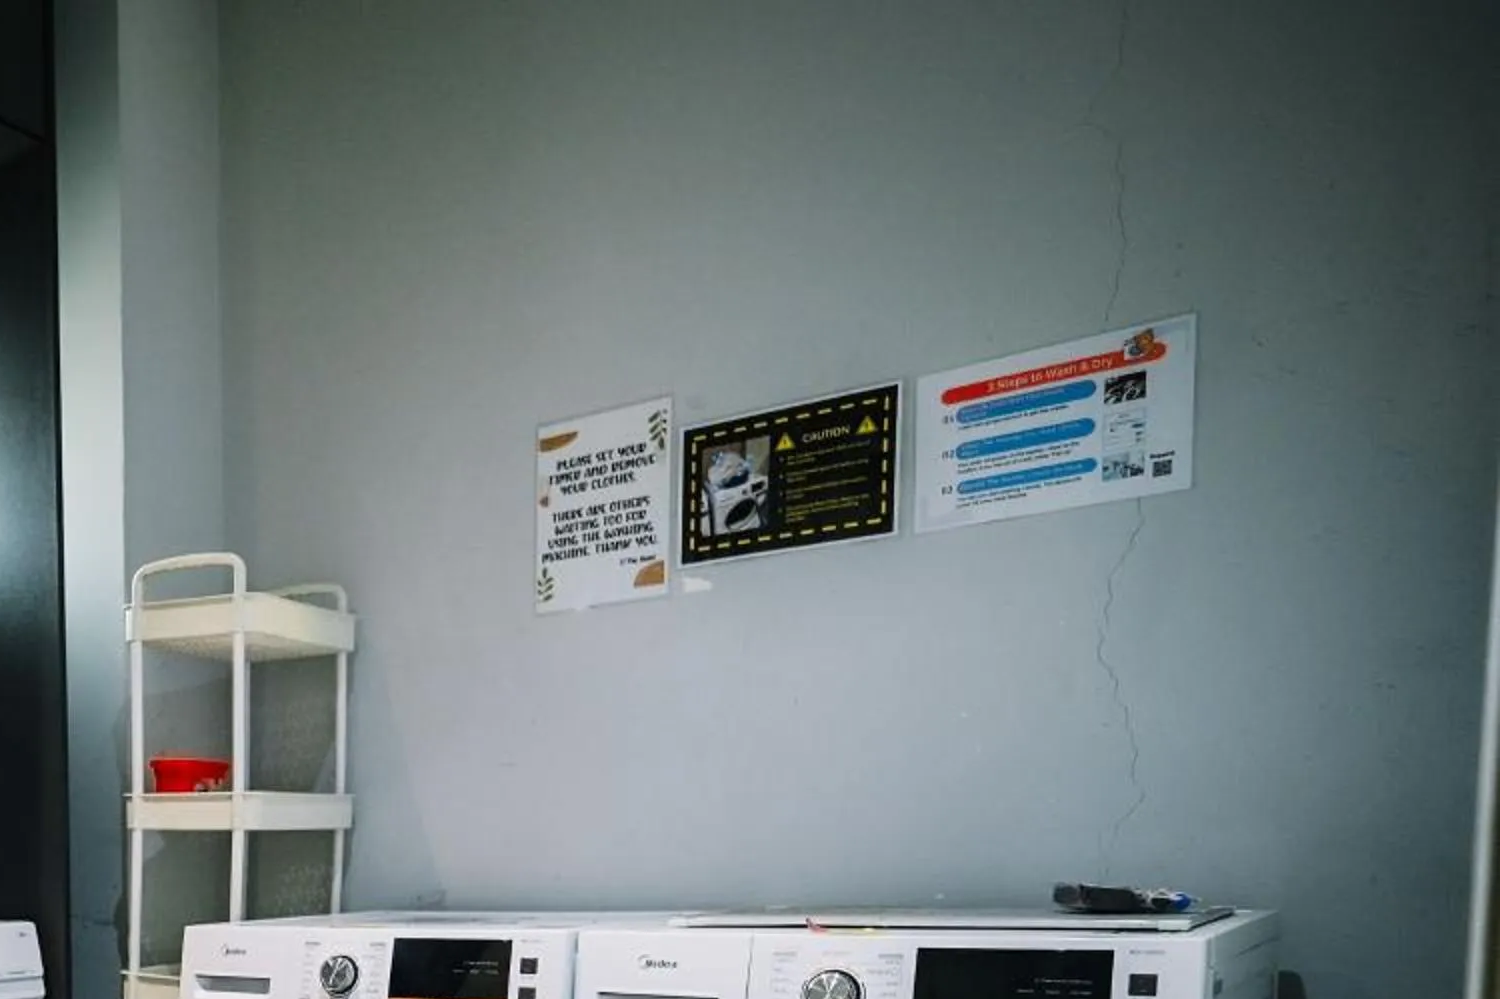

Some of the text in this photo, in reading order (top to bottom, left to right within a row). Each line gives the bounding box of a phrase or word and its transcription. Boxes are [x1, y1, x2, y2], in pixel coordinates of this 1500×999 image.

[999, 374, 1028, 390] Steps
[1031, 370, 1044, 382] to
[1046, 364, 1078, 381] Wash
[1092, 358, 1113, 373] Dry
[802, 426, 850, 443] CAUTION
[557, 442, 647, 471] PLEASE SET YOUR
[584, 463, 608, 477] AND
[611, 454, 656, 472] REMOVE
[560, 480, 588, 496] YOUR
[552, 509, 583, 523] THERE
[586, 504, 606, 517] ARE
[554, 510, 647, 536] WAITING TOO FOR
[582, 530, 601, 544] THE
[638, 953, 678, 969] Midea
